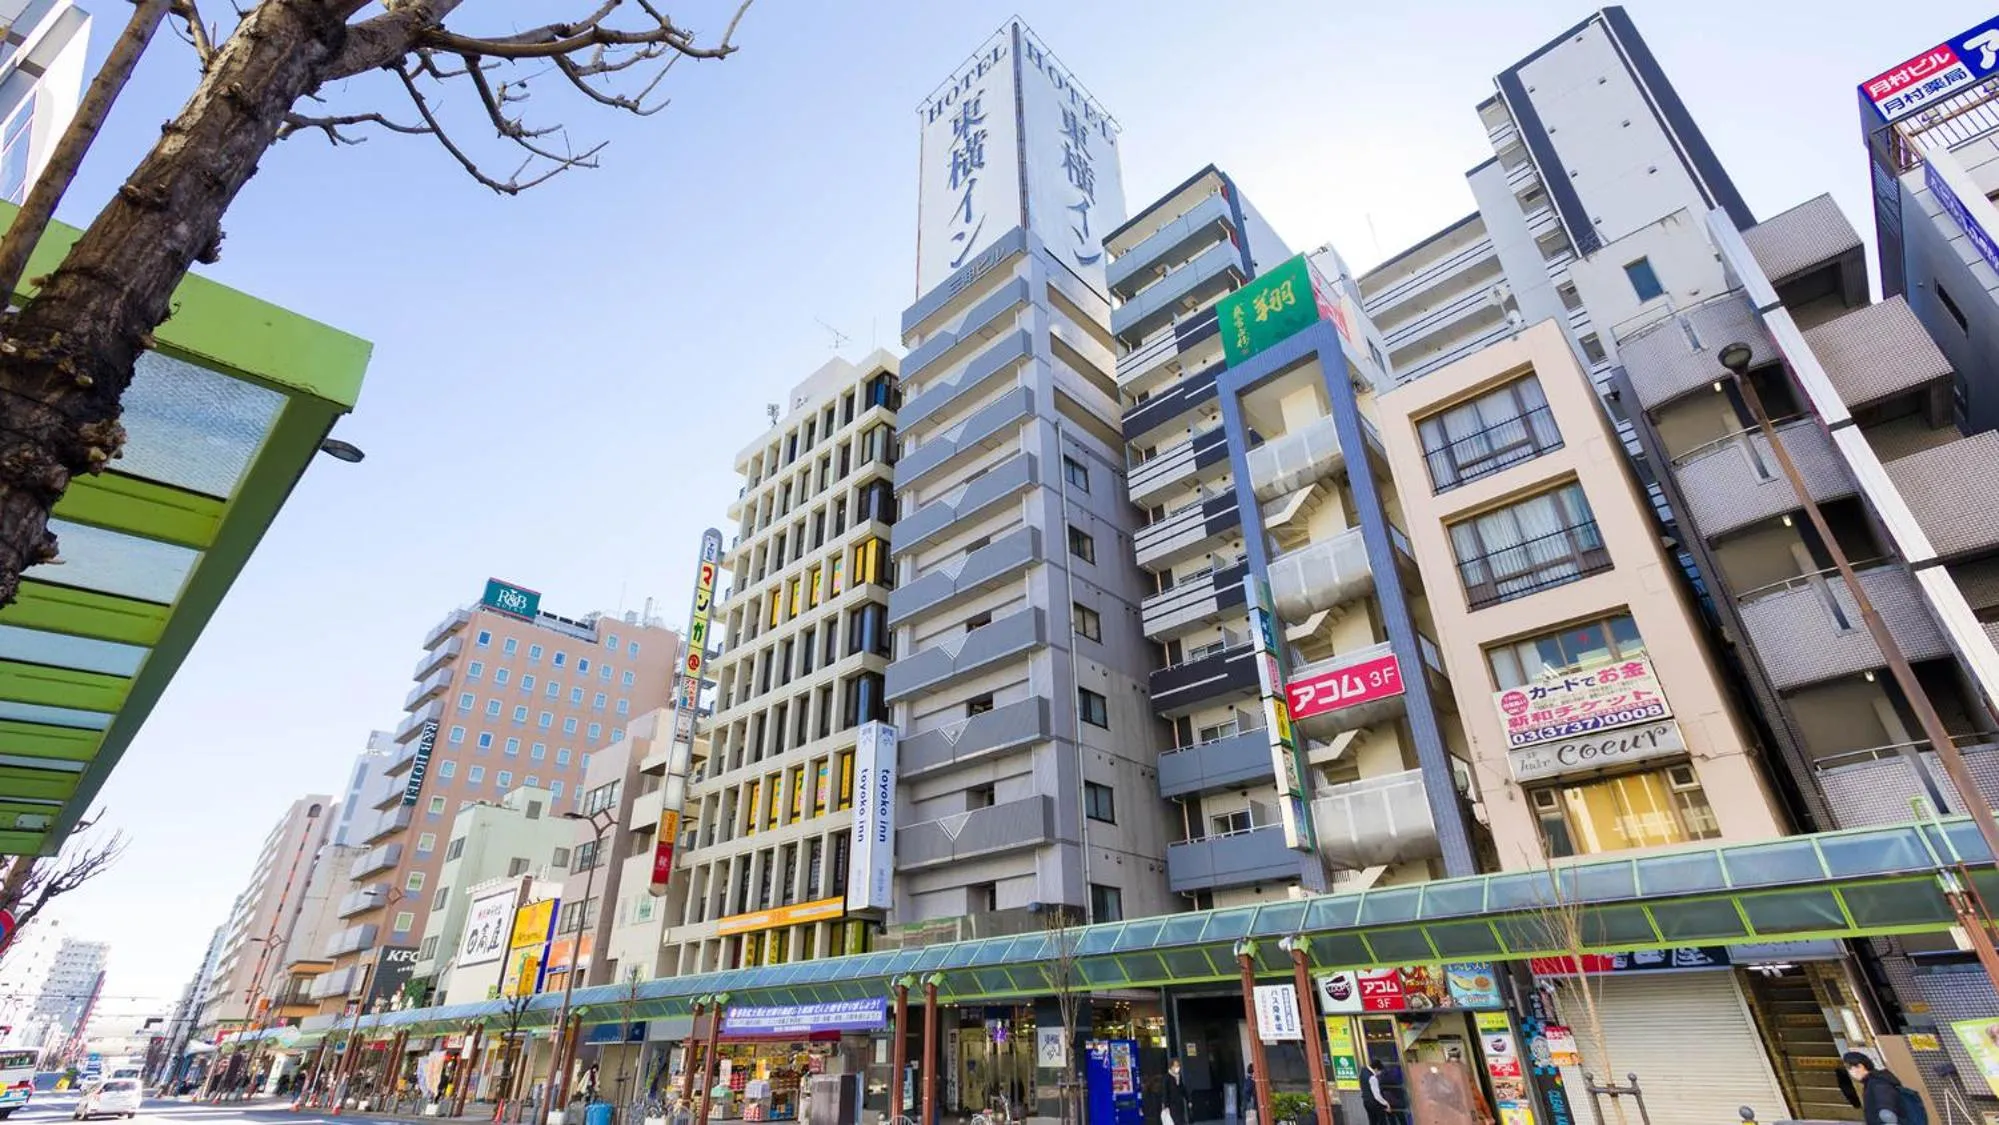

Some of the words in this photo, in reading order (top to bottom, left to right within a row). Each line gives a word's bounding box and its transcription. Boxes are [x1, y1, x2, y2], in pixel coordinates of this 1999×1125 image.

[928, 44, 1008, 125] HOTEL
[1025, 39, 1115, 146] HOTEL
[1869, 50, 1951, 98] 月村ビル
[1883, 67, 1969, 116] 月村薬局
[948, 88, 989, 269] 東横イン
[1057, 100, 1102, 267] 東横イン
[497, 587, 528, 609] R&B
[1291, 672, 1367, 713] アコム
[1368, 666, 1395, 689] 3F
[1528, 660, 1647, 701] カードでお金
[1508, 690, 1654, 728] 新和チケット
[1512, 704, 1664, 745] 03(3737)0008
[1557, 725, 1668, 766] Coeur
[858, 768, 869, 817] toyoko
[880, 769, 891, 817] toyoko
[857, 819, 868, 842] inn
[879, 820, 889, 843] inn
[386, 950, 421, 962] KFC
[1362, 979, 1399, 994] アコム
[1376, 998, 1392, 1008] 3F
